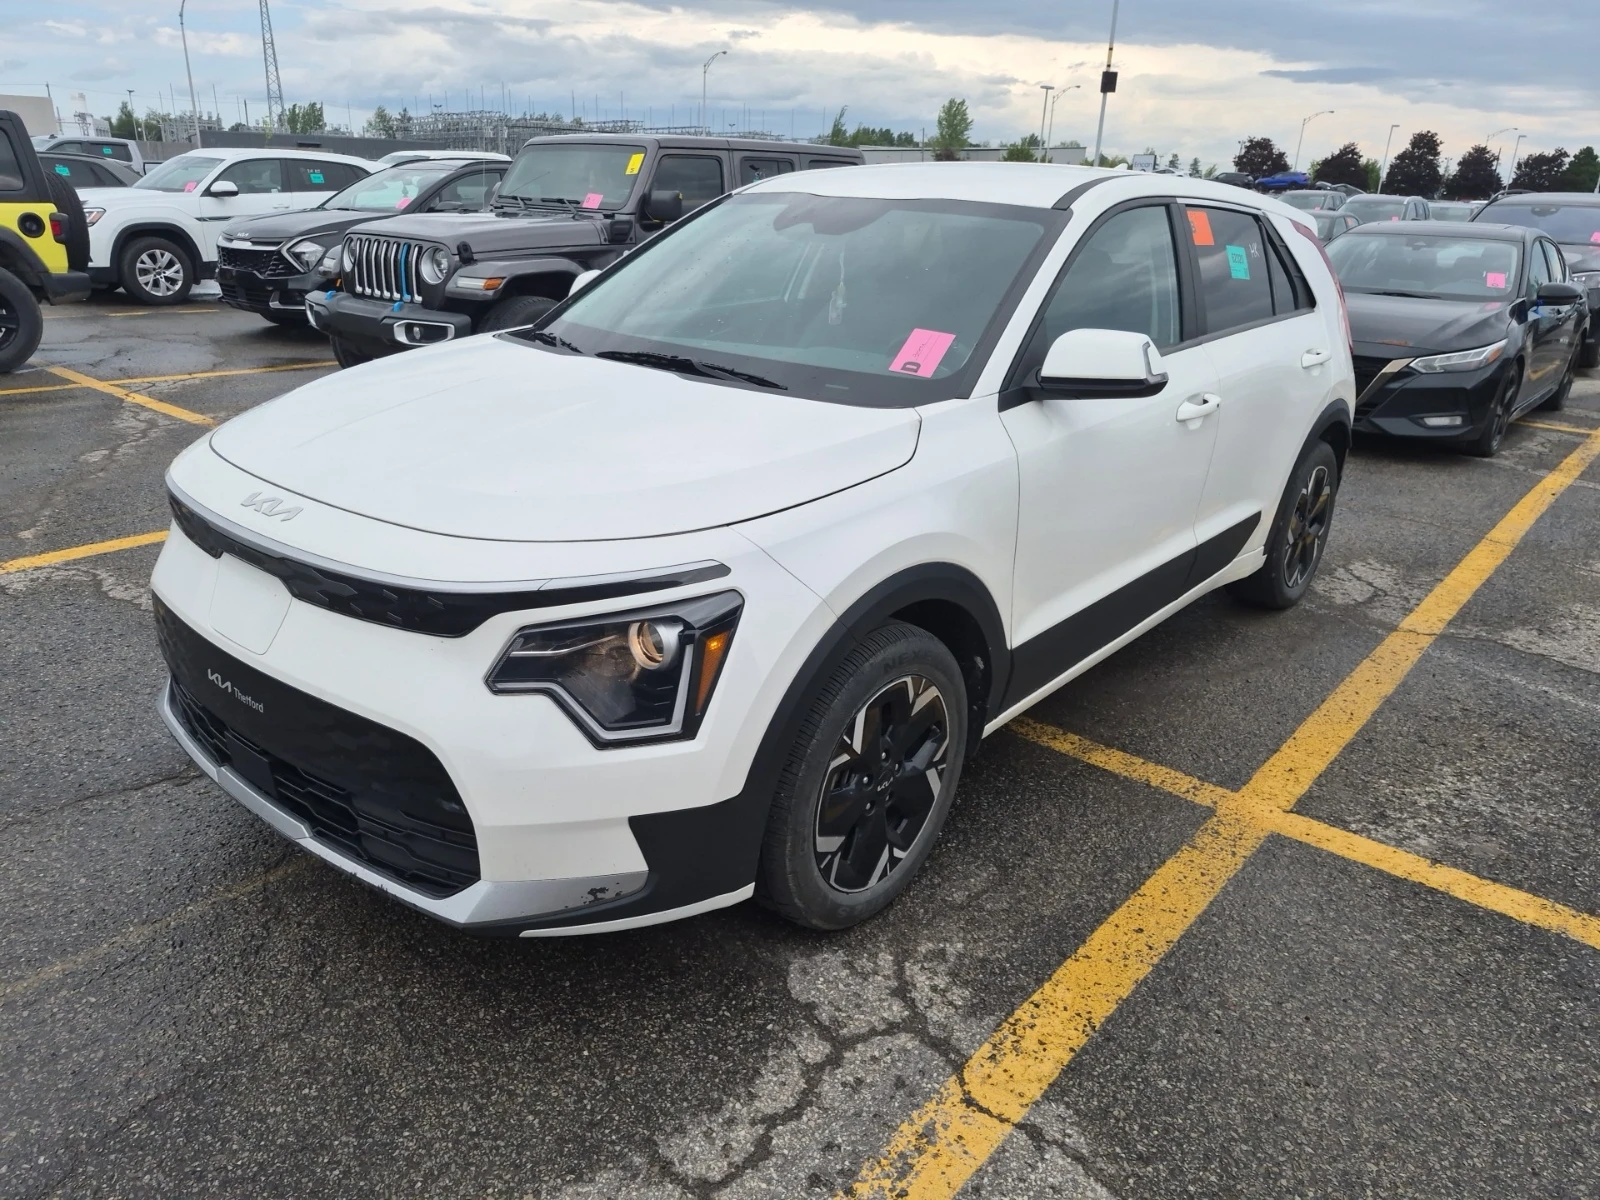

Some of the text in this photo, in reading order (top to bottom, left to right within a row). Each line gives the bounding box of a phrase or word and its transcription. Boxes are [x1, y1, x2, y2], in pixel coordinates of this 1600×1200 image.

[900, 361, 921, 373] D
[240, 491, 304, 522] KIA
[207, 668, 232, 693] KIA
[233, 687, 264, 713] Thetford
[877, 776, 894, 792] KIA
